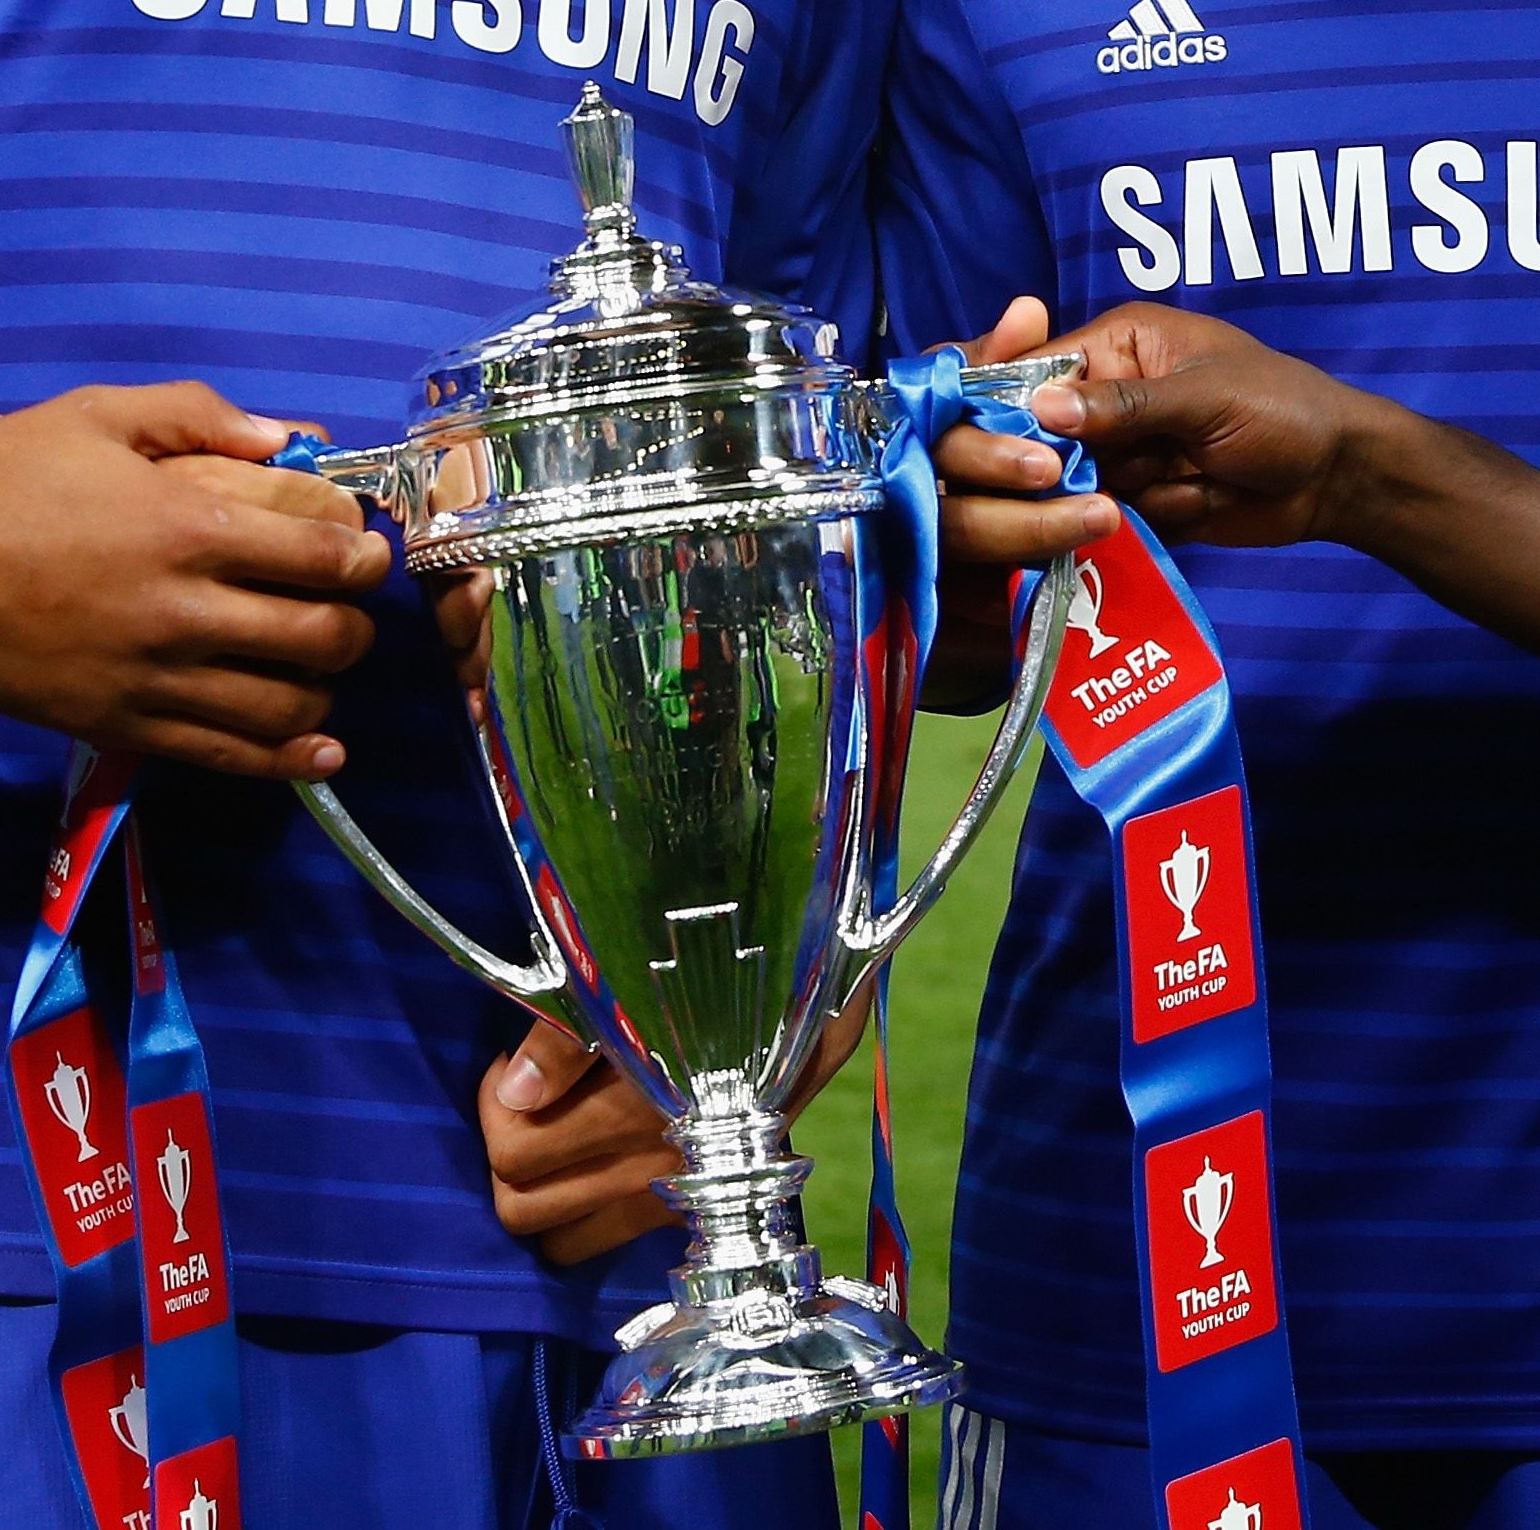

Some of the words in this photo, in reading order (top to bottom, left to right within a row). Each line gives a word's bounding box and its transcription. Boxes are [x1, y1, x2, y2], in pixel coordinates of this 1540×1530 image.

[1096, 31, 1229, 74] adidas
[1091, 686, 1148, 728] YOUTH
[1146, 666, 1178, 694] CUP
[1157, 984, 1200, 1011] YOUTH
[1201, 976, 1227, 996] CUP
[76, 1204, 116, 1233] YOUTH
[116, 1194, 134, 1214] CU
[163, 1293, 193, 1314] YOUTH
[193, 1287, 210, 1305] CUP
[1181, 1311, 1224, 1339] YOUTH
[1225, 1301, 1250, 1322] CUP
